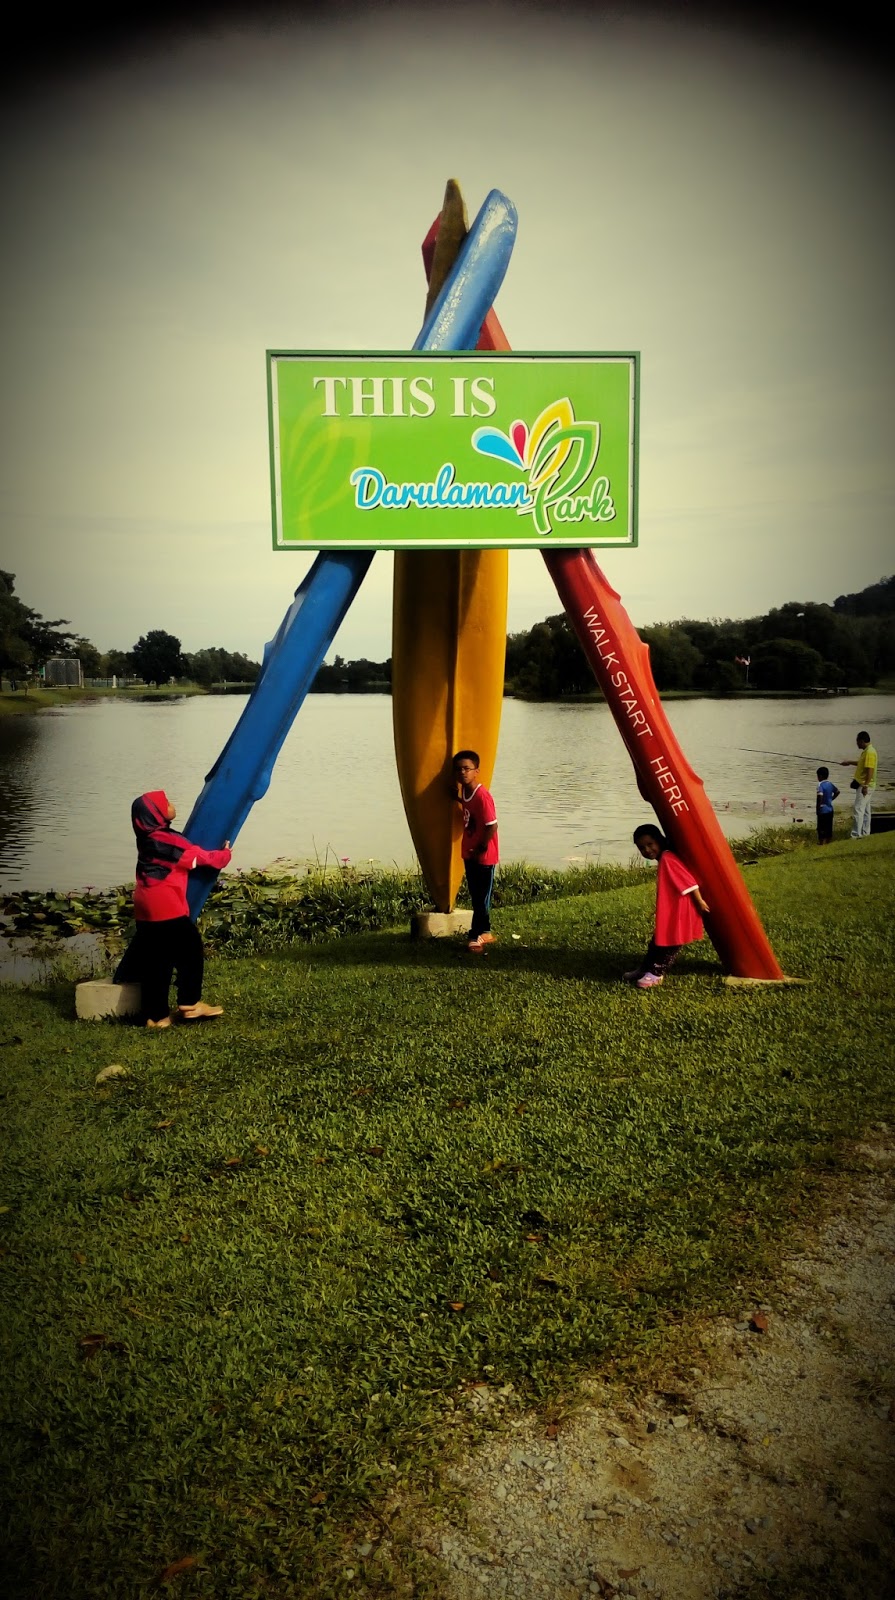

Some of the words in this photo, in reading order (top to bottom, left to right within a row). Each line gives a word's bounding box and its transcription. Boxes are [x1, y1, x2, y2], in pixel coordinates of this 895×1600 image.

[313, 376, 436, 417] THIS
[450, 376, 497, 417] IS
[350, 463, 531, 510] Darulaman
[516, 421, 616, 534] Park
[583, 605, 620, 669] WALK
[611, 671, 653, 737] START
[650, 756, 690, 816] HERE
